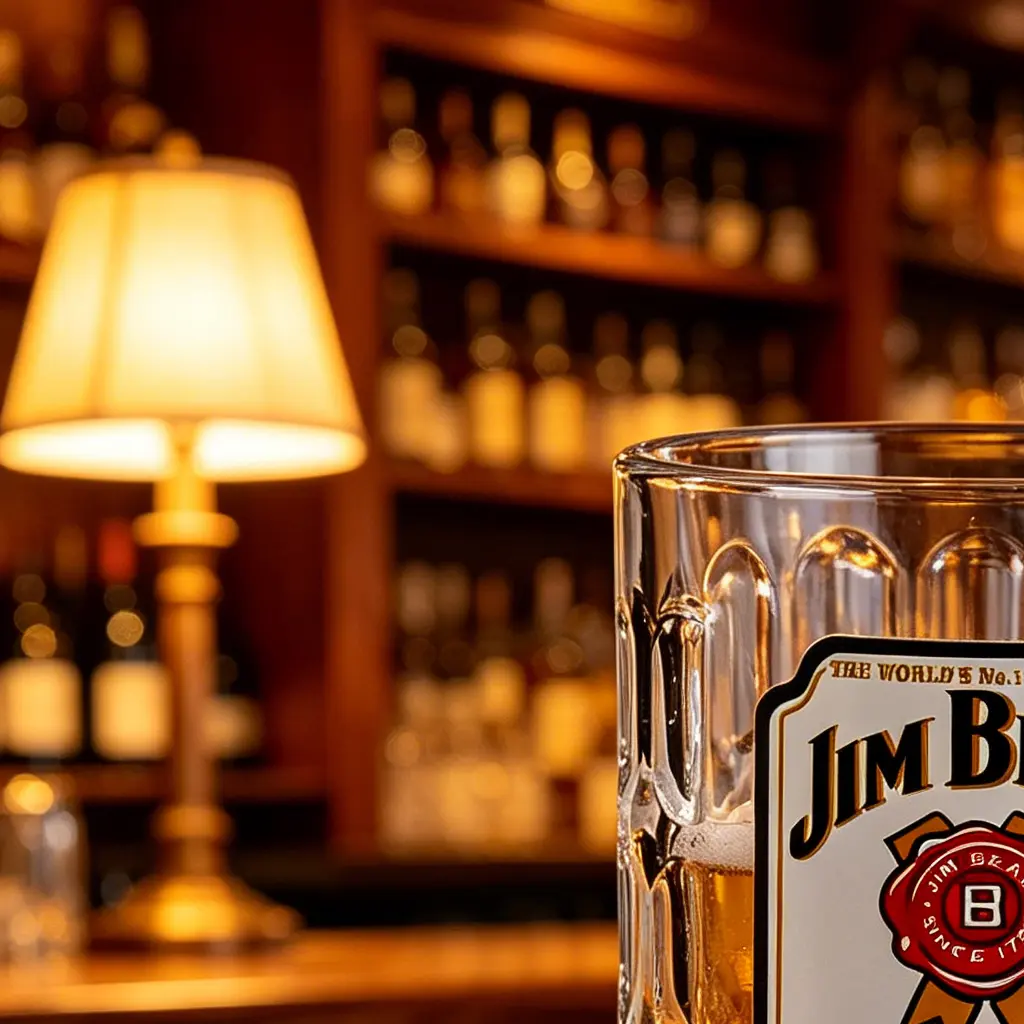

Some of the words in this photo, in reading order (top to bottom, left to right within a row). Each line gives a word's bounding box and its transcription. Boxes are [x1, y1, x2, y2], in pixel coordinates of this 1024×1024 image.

[829, 660, 871, 680] THE
[789, 716, 936, 861] JIM
[964, 885, 1002, 927] B
[923, 915, 985, 963] SINCE
